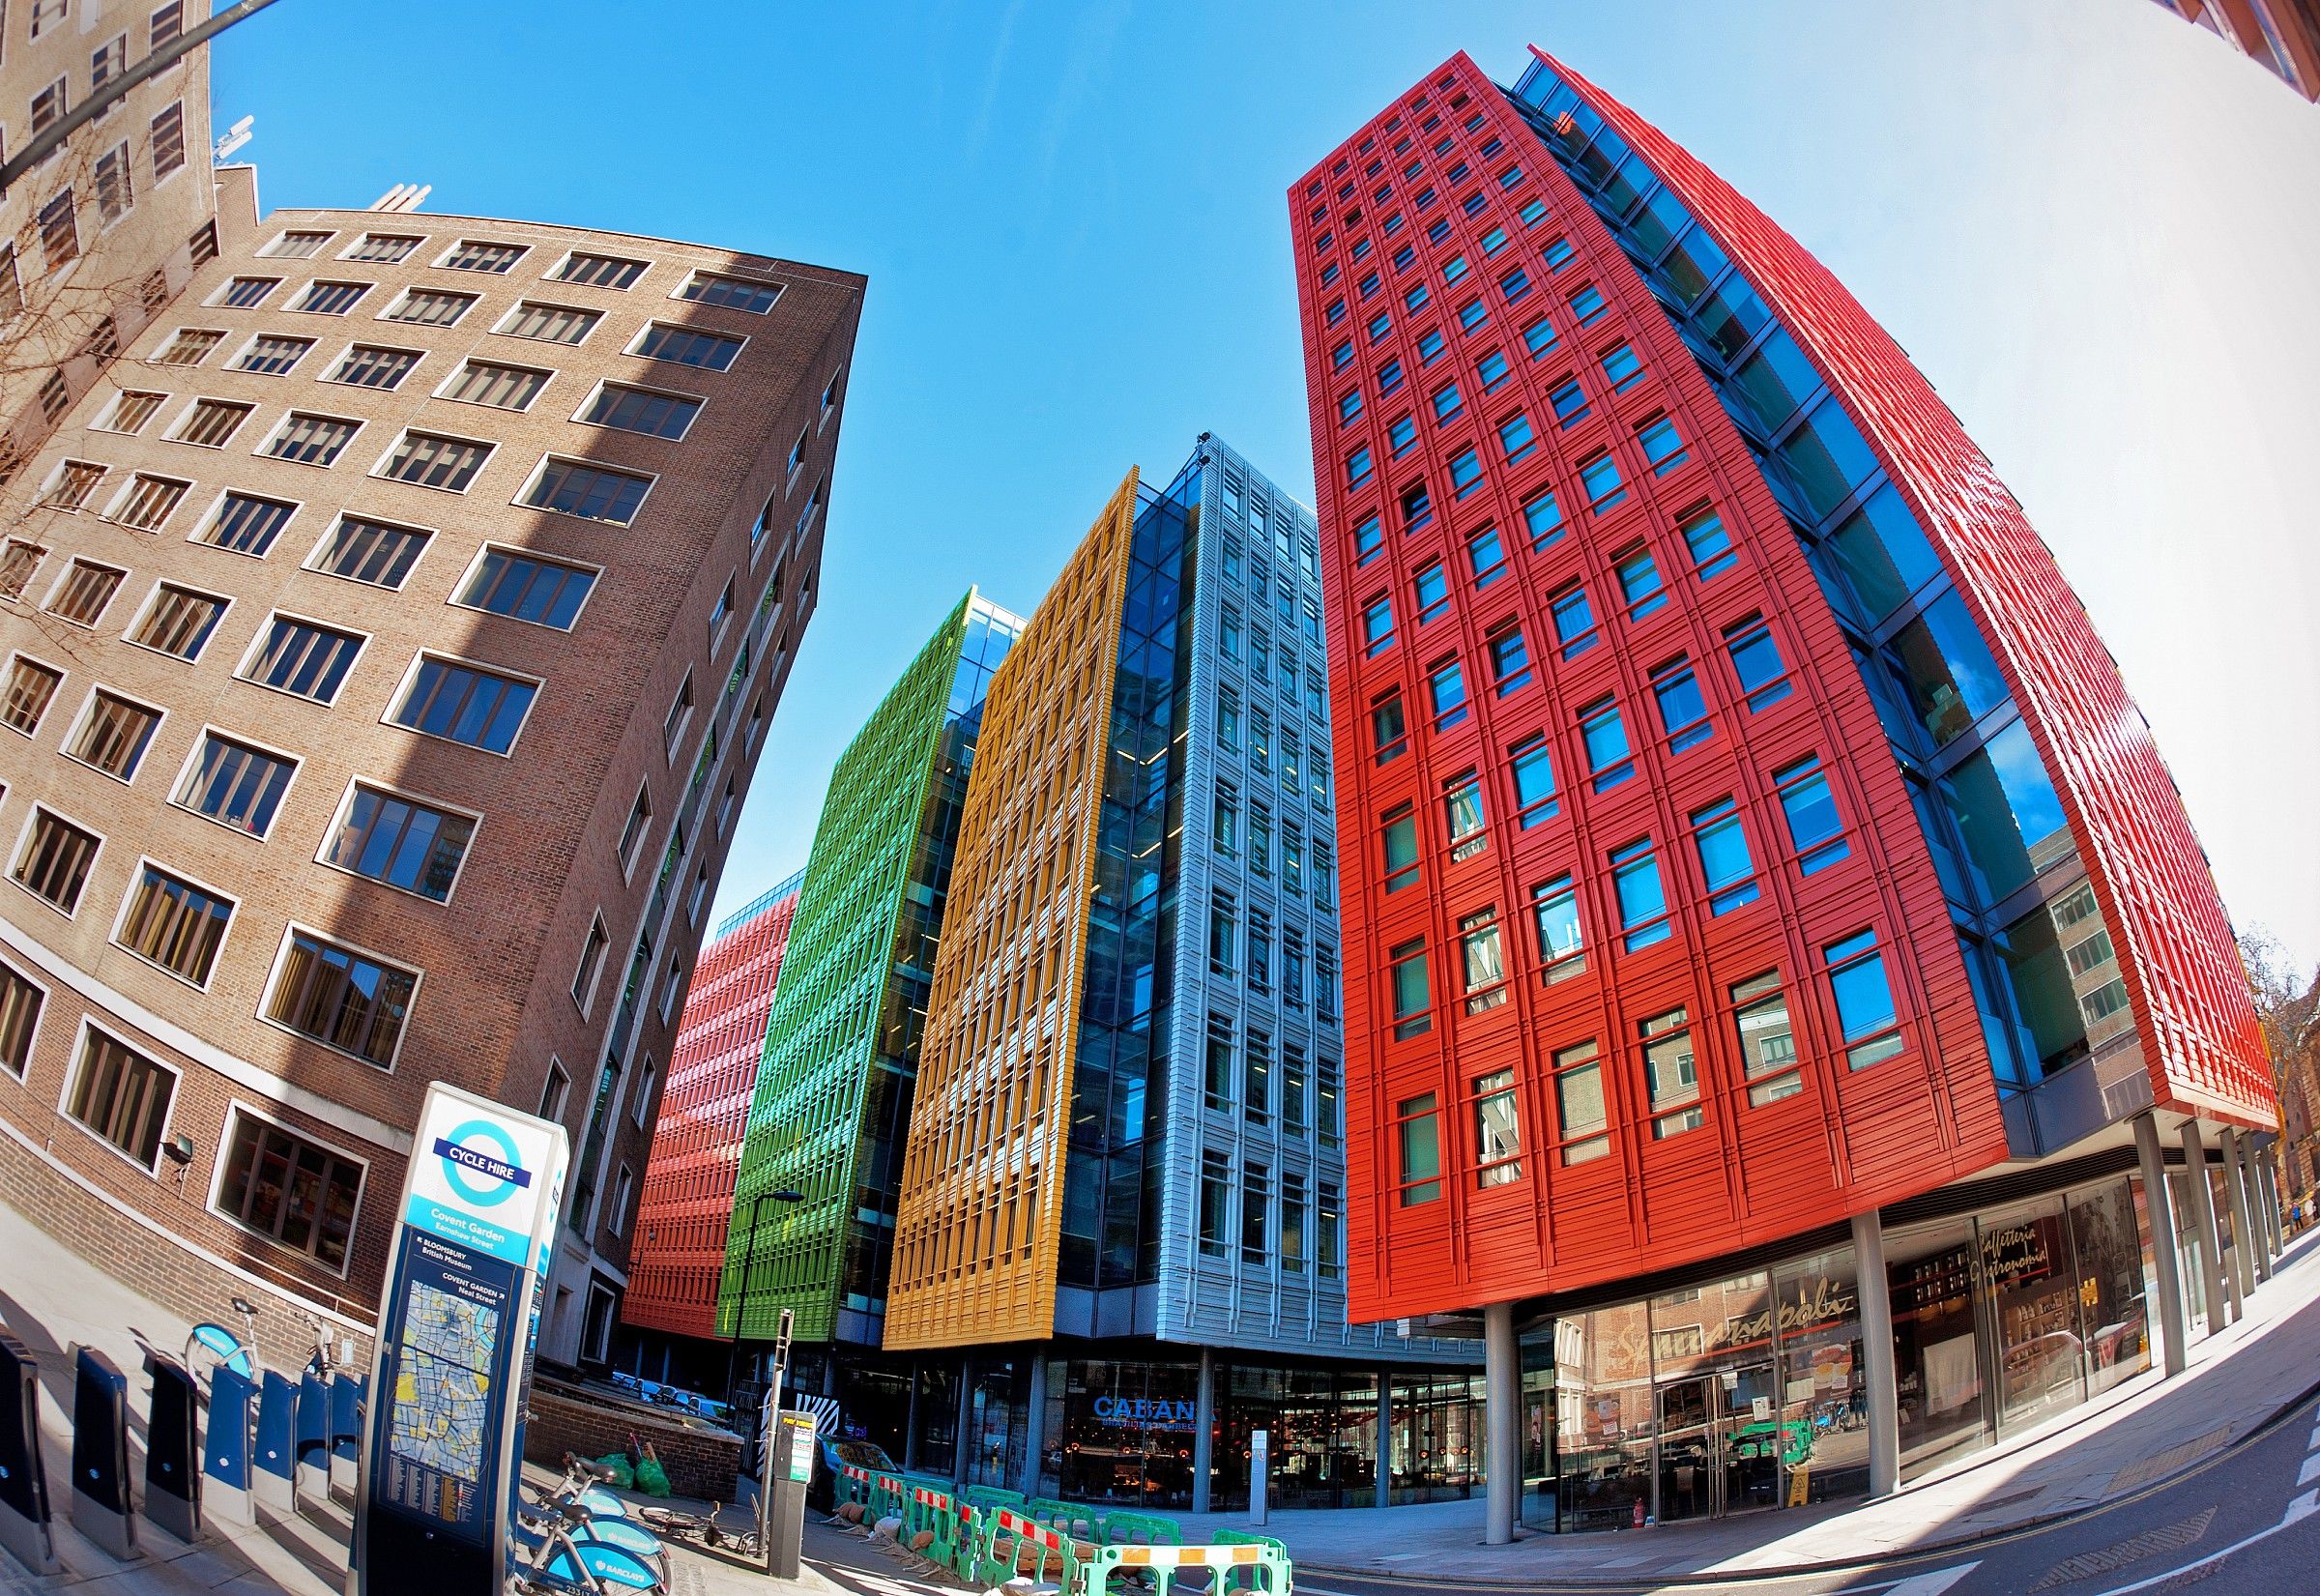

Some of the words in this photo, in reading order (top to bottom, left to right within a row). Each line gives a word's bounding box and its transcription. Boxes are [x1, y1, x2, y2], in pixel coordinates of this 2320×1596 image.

[449, 1146, 486, 1170] CYCLE
[486, 1161, 515, 1180] HIRE
[430, 1207, 467, 1229] Covent
[468, 1223, 506, 1243] Garden
[435, 1222, 471, 1240] Earnshaw
[471, 1235, 495, 1250] Street
[421, 1246, 444, 1261] British
[444, 1256, 473, 1271] Museum
[423, 1238, 467, 1261] BLOOMSBURY
[442, 1272, 470, 1287] COVENT
[470, 1283, 499, 1298] GARDEN
[458, 1286, 476, 1298] Neal
[475, 1291, 497, 1306] Street
[1093, 1395, 1217, 1421] CABAN
[606, 1564, 646, 1582] BARCLAYS
